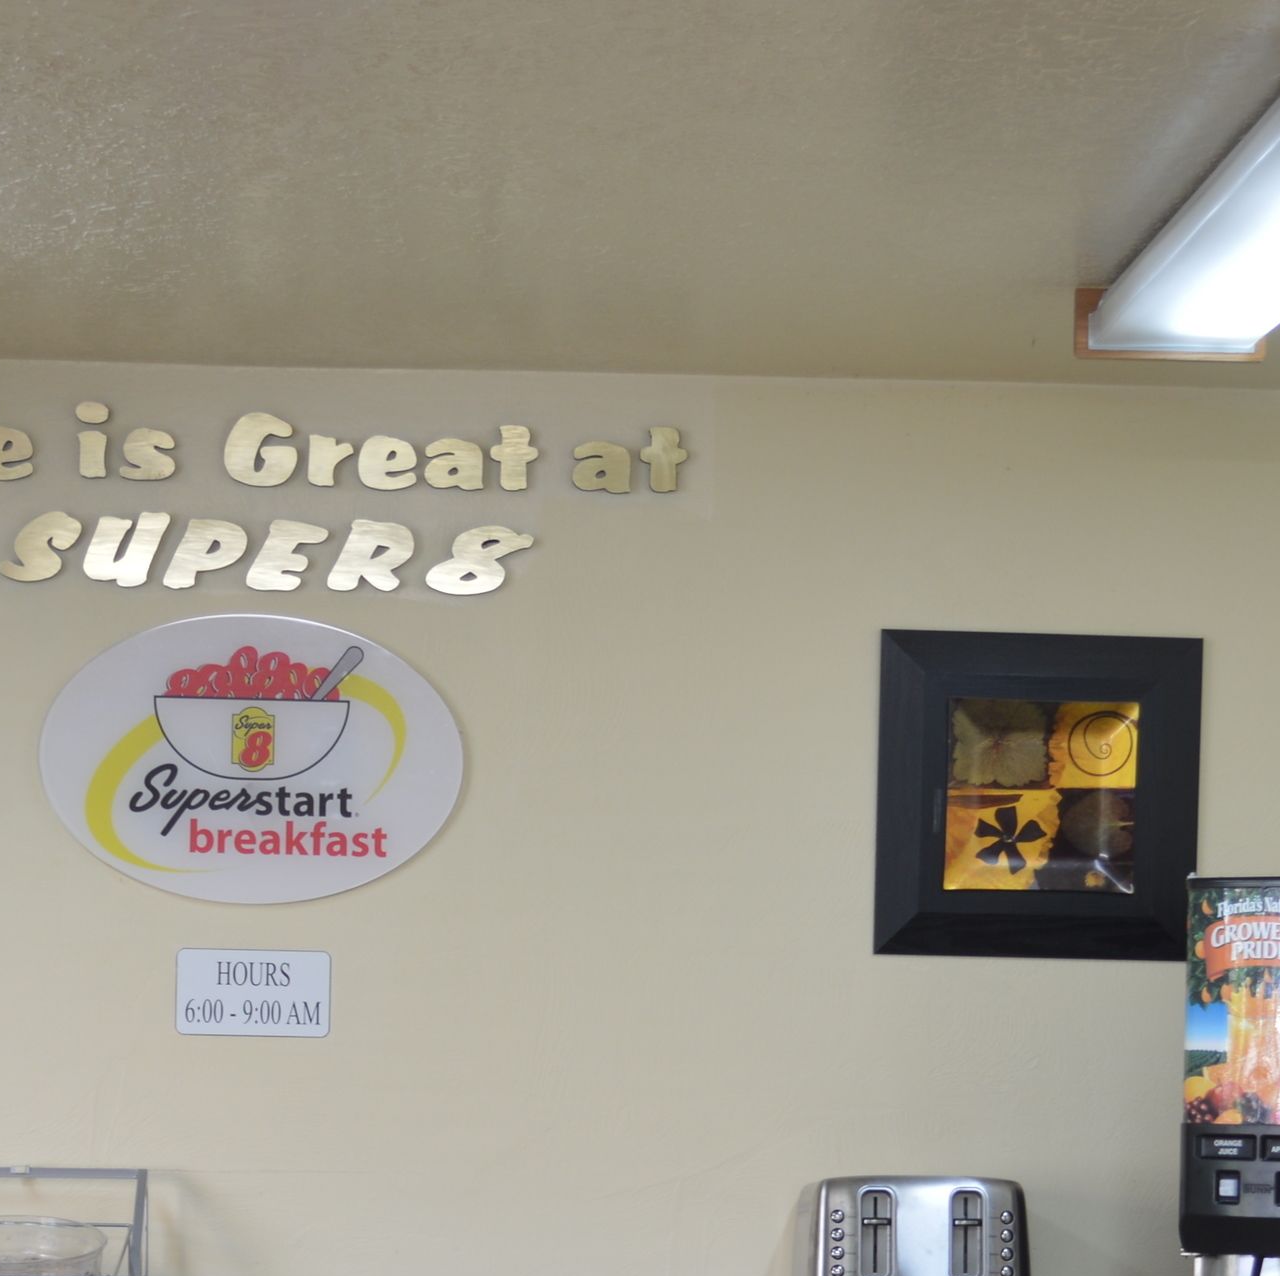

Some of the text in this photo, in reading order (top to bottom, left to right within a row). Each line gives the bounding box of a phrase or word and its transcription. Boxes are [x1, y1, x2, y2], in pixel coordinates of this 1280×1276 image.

[75, 401, 177, 480] is
[223, 411, 539, 492] Great
[571, 425, 688, 493] at
[424, 525, 535, 596] 8
[235, 714, 272, 737] Super
[238, 730, 273, 768] 8
[129, 763, 353, 837] Superstart
[189, 818, 388, 858] breakfast
[216, 961, 291, 987] HOURS
[184, 998, 224, 1024] 6:00
[242, 999, 282, 1025] 9:00
[286, 1001, 321, 1025] AM
[1213, 1139, 1243, 1147] ORANGE
